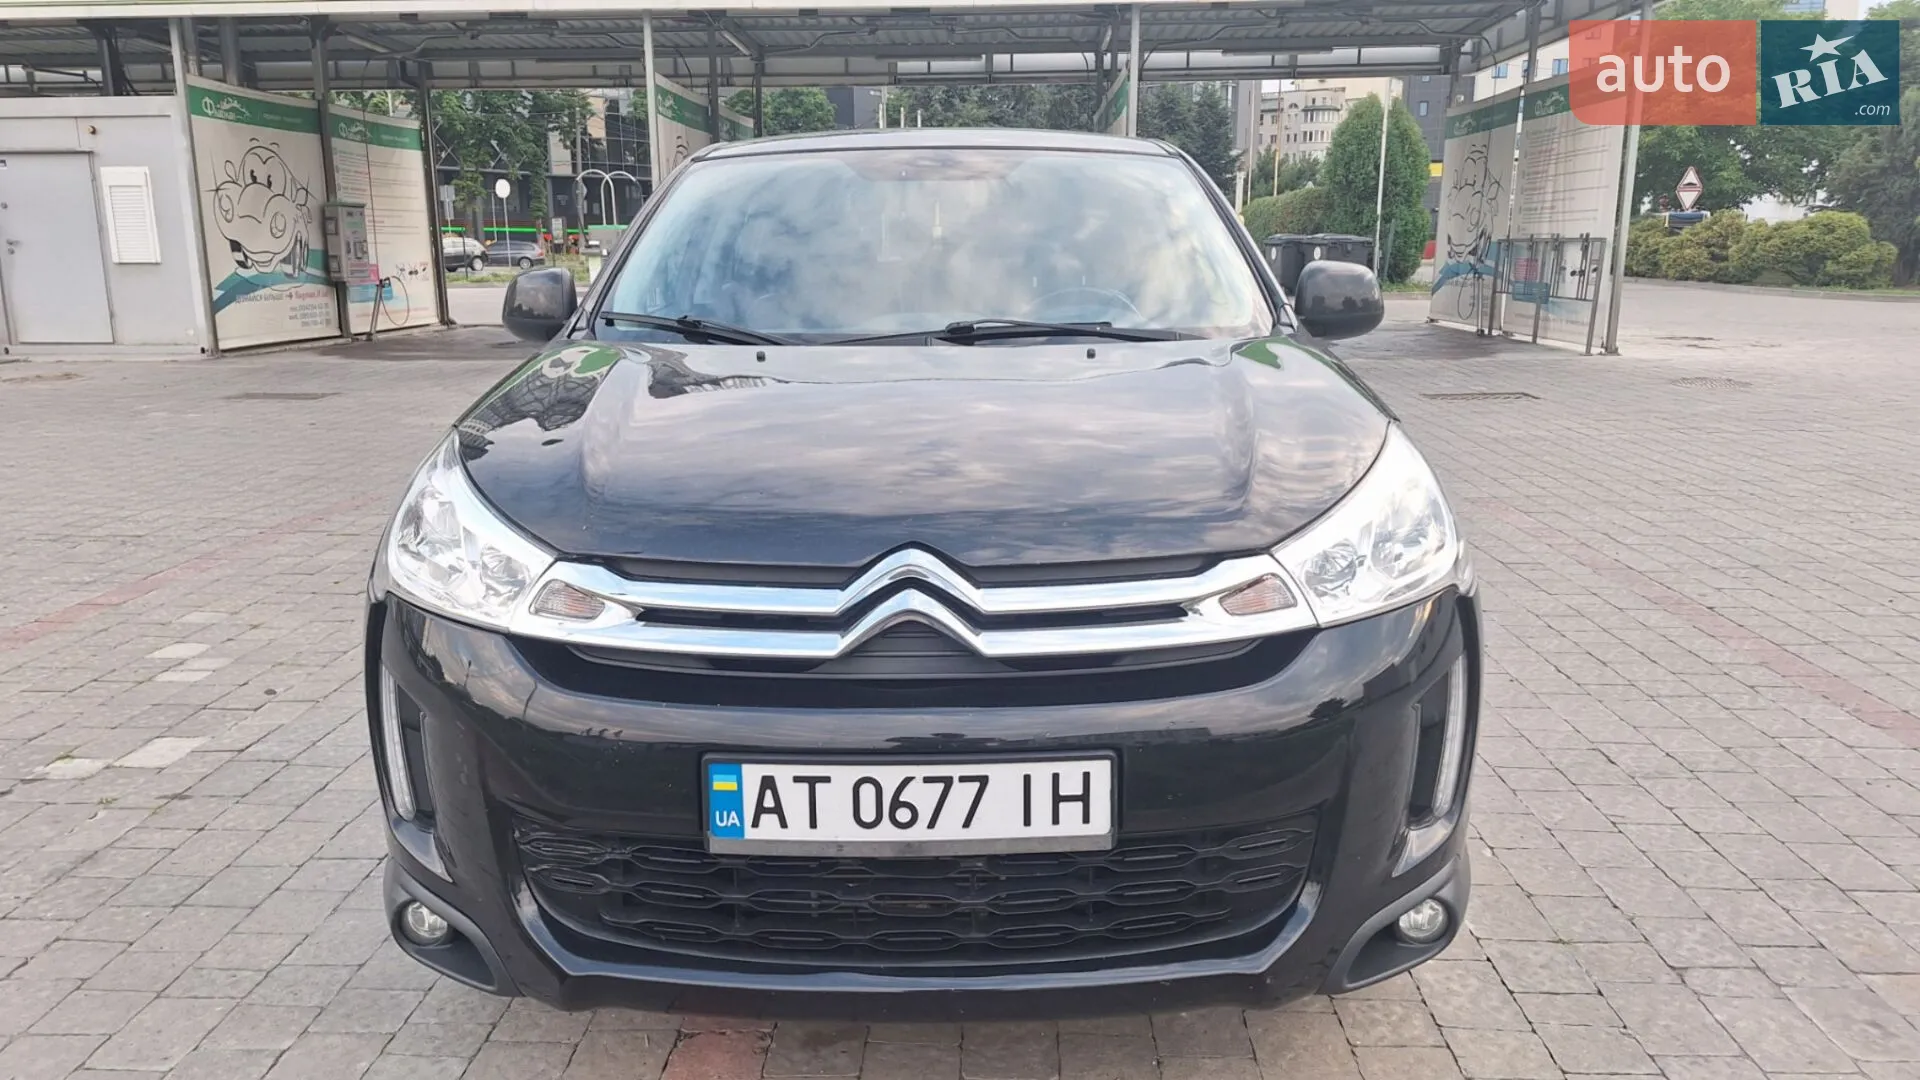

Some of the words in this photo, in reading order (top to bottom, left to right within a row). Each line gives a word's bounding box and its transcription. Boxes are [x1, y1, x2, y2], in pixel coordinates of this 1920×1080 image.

[715, 810, 741, 827] UA
[751, 774, 832, 829] AT
[852, 774, 989, 830] 0677
[1022, 771, 1091, 827] IH
